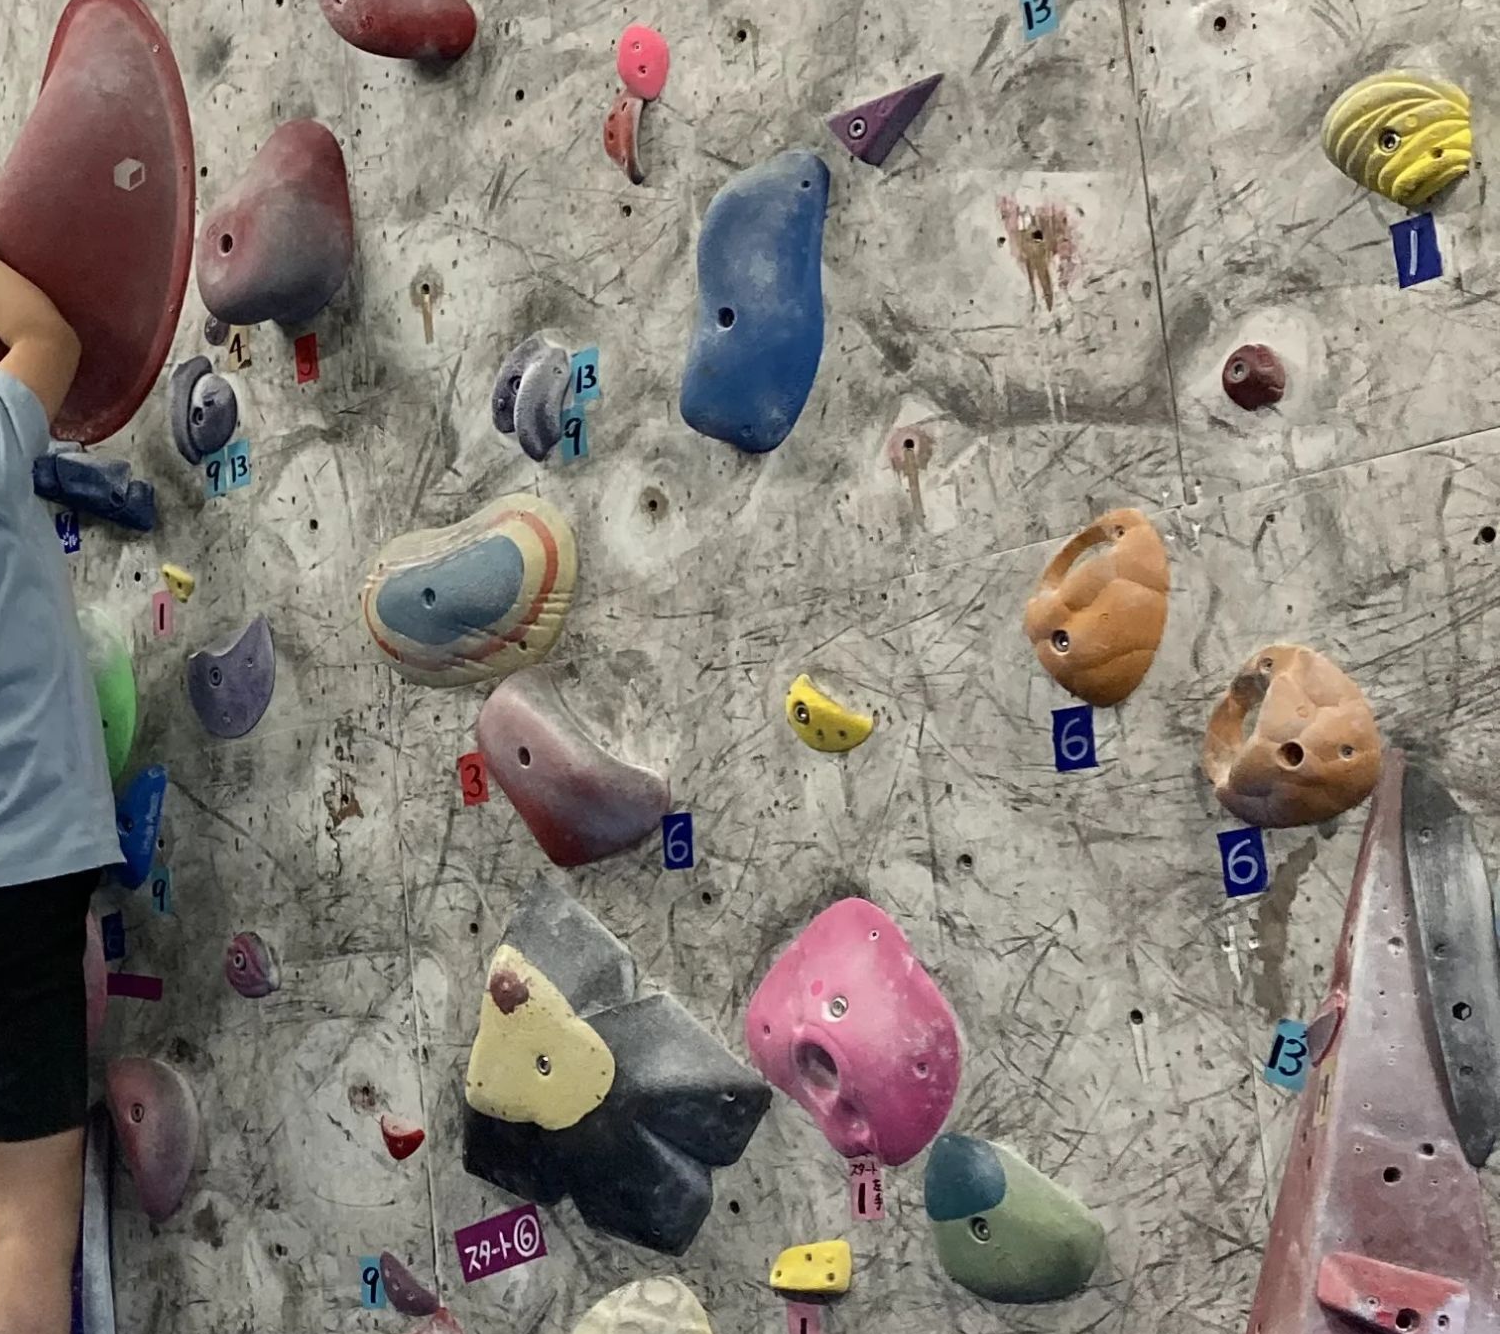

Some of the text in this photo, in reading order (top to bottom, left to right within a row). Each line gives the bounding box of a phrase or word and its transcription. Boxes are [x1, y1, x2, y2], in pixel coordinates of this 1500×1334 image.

[1409, 229, 1418, 276] 1
[229, 332, 246, 363] 4
[576, 363, 598, 394] 13
[564, 417, 581, 455] 9
[206, 460, 220, 491] 9
[231, 454, 248, 480] 13
[1060, 717, 1089, 761] 6
[462, 763, 483, 799] 3
[666, 821, 689, 863] 6
[1227, 838, 1260, 884] 6
[152, 879, 166, 912] 9
[1268, 1032, 1307, 1077] 13
[858, 1182, 866, 1214] 1
[362, 1266, 379, 1303] 9
